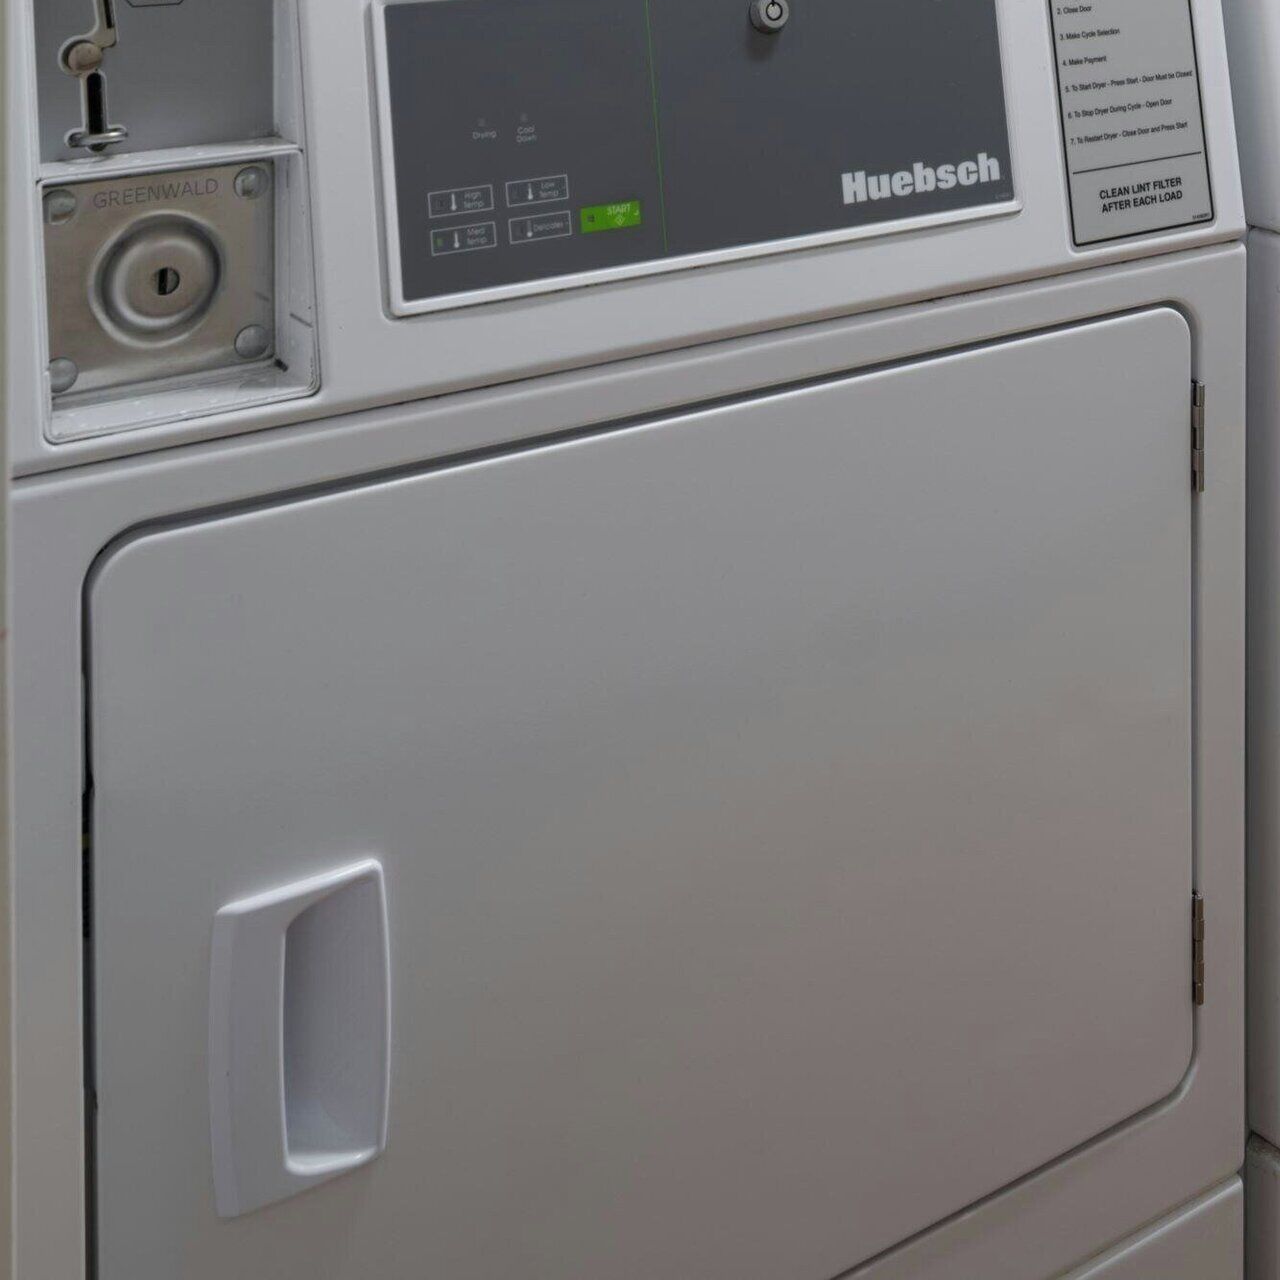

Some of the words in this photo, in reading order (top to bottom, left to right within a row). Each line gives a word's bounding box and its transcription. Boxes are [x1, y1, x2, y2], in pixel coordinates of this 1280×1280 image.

[1082, 30, 1096, 39] Cycle
[1097, 28, 1120, 37] Selection
[1069, 58, 1083, 66] Make
[1084, 56, 1107, 65] Payment
[1079, 82, 1092, 91] Start
[1093, 81, 1107, 91] Dryer
[1126, 76, 1138, 85] Start
[1142, 75, 1155, 83] Door
[1095, 107, 1109, 117] Dryer
[1110, 104, 1126, 114] During
[1127, 102, 1141, 111] Cycle
[1146, 100, 1160, 109] Open
[1160, 98, 1172, 107] Door
[472, 130, 497, 140] Drying
[517, 125, 535, 135] Cool
[1084, 134, 1103, 143] Restart
[1104, 132, 1118, 141] Dryer
[1122, 130, 1137, 138] Close
[1138, 127, 1150, 136] Door
[1175, 121, 1188, 130] Start
[841, 152, 1000, 205] Huebsch
[92, 178, 219, 209] GREENWALD
[1099, 186, 1130, 200] CLEAN
[1131, 182, 1151, 194] LINT
[1152, 177, 1182, 190] FILTER
[607, 204, 631, 216] START
[1102, 199, 1131, 213] AFTER
[1133, 195, 1157, 207] EACH
[1159, 190, 1183, 202] LOAD
